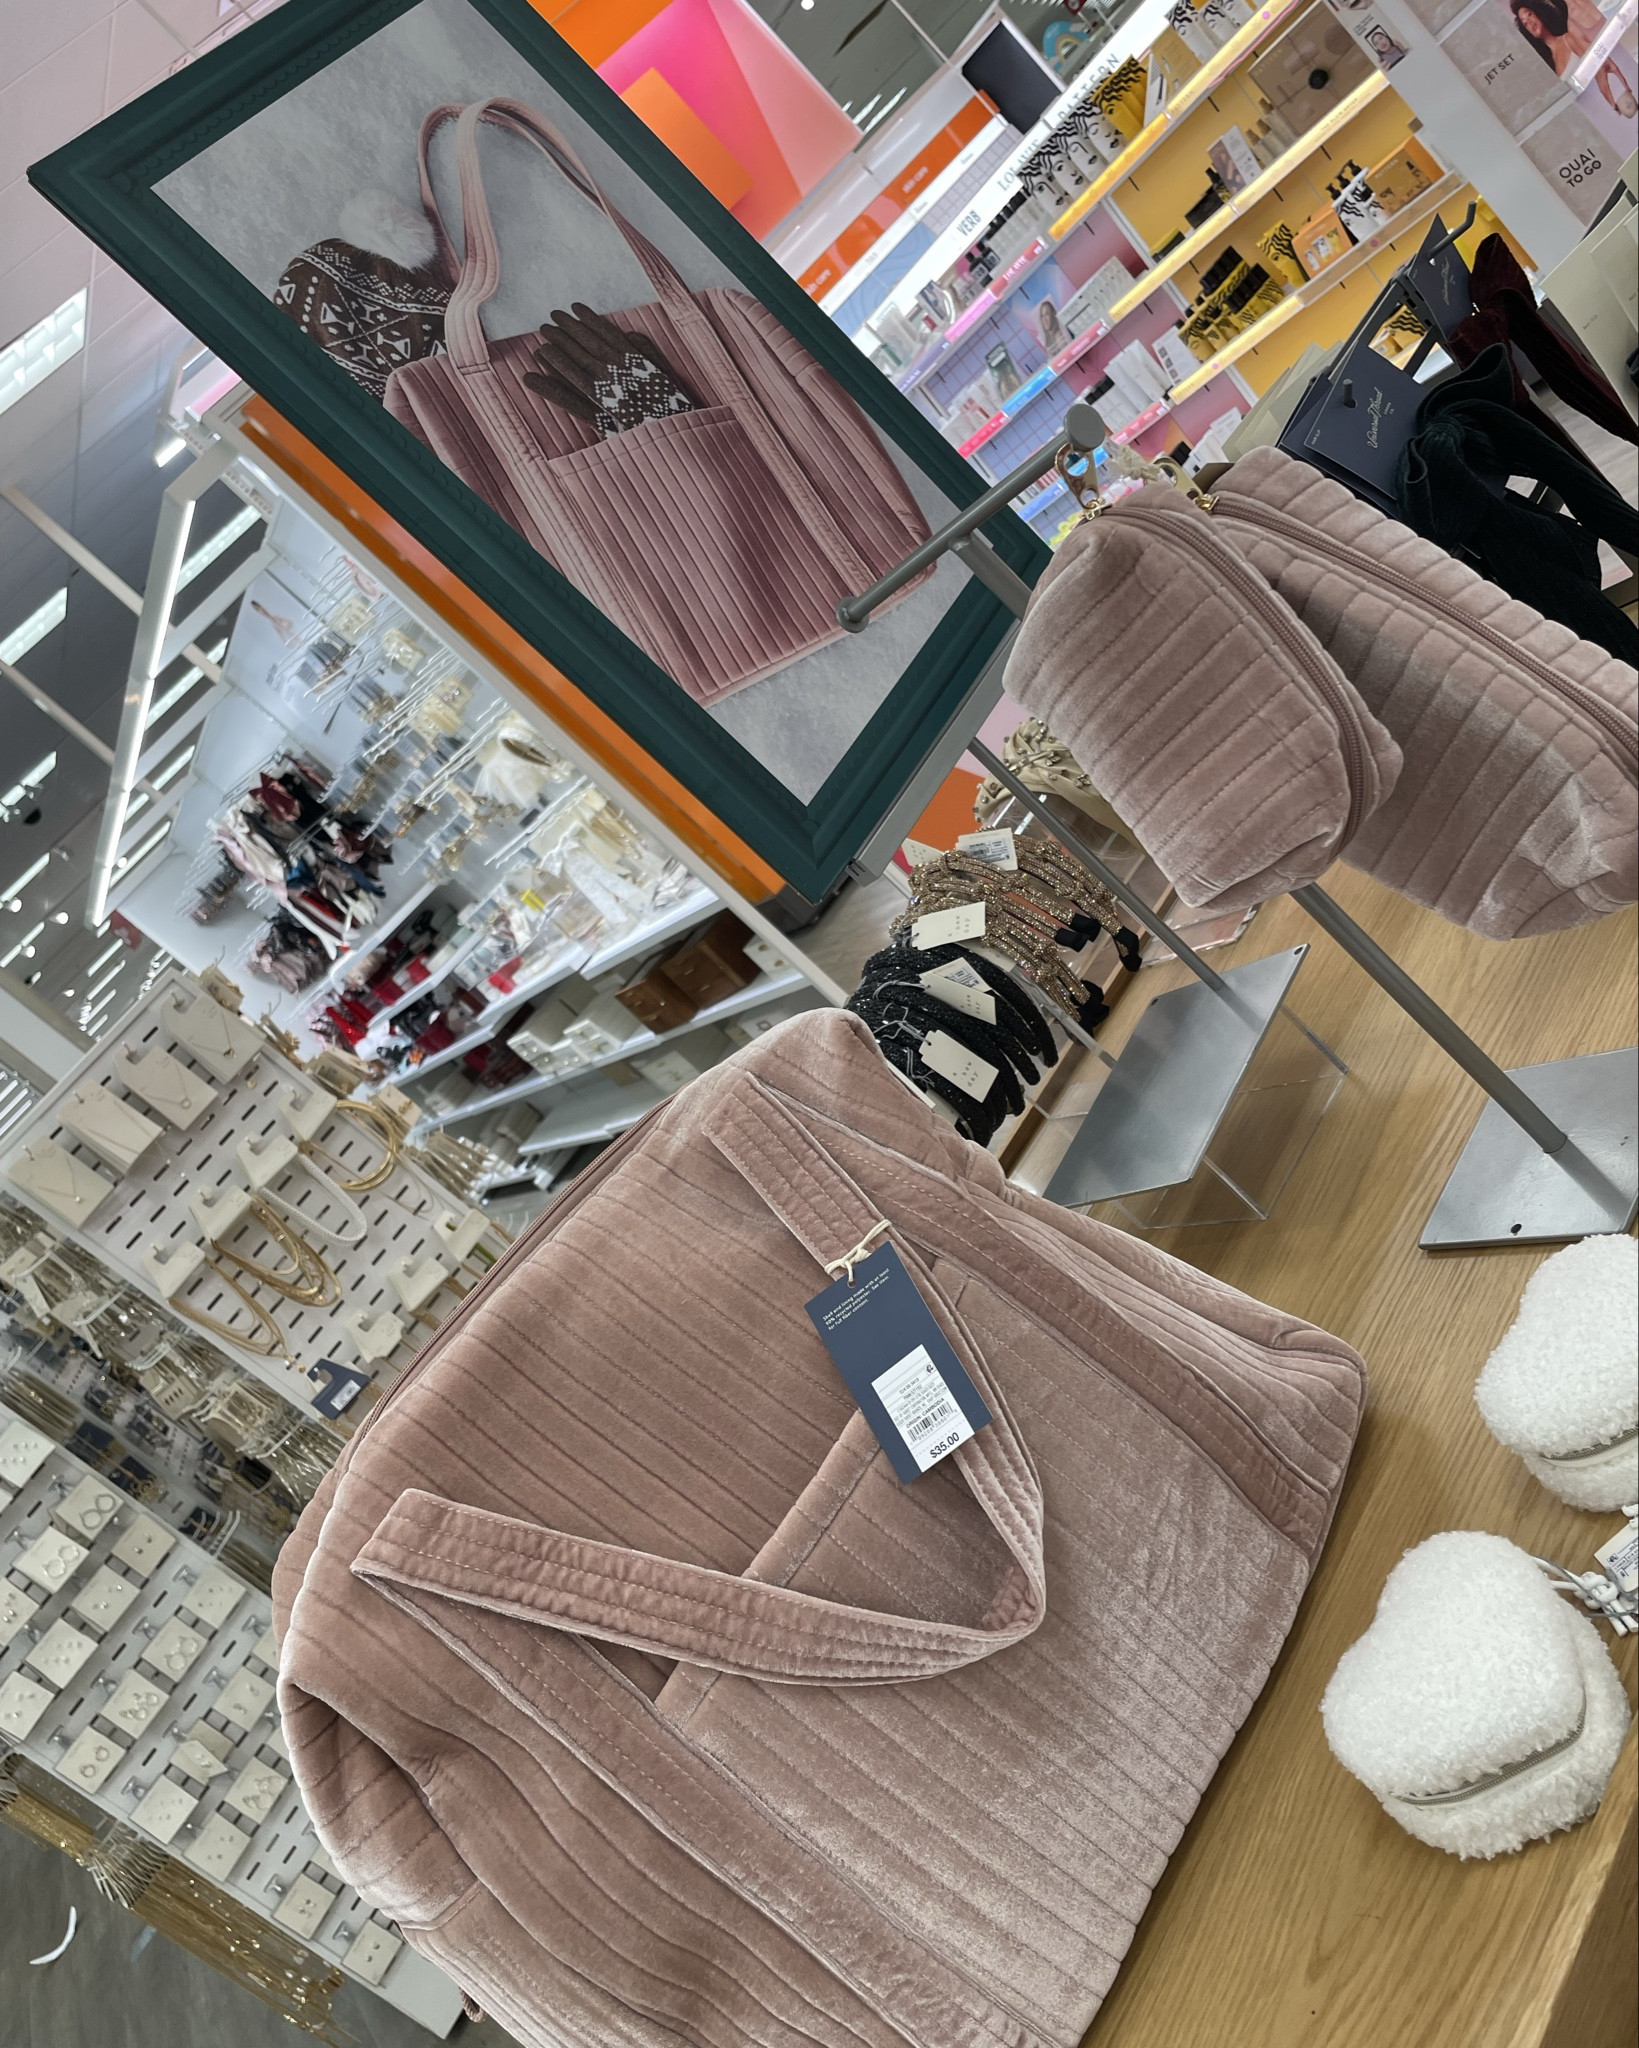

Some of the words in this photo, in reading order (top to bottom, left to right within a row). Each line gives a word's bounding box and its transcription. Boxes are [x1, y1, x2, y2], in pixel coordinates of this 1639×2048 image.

[1484, 67, 1498, 85] JET
[1498, 53, 1515, 71] SET
[1559, 148, 1596, 179] OUAI
[1567, 174, 1584, 188] TO
[1584, 160, 1602, 176] GO
[956, 209, 982, 237] VERB
[853, 1288, 864, 1298] made
[865, 1280, 874, 1289] with
[879, 1268, 890, 1277] least
[836, 1304, 852, 1319] recycled
[922, 1398, 944, 1416] CAMBODIA
[930, 1432, 959, 1458] $35.00
